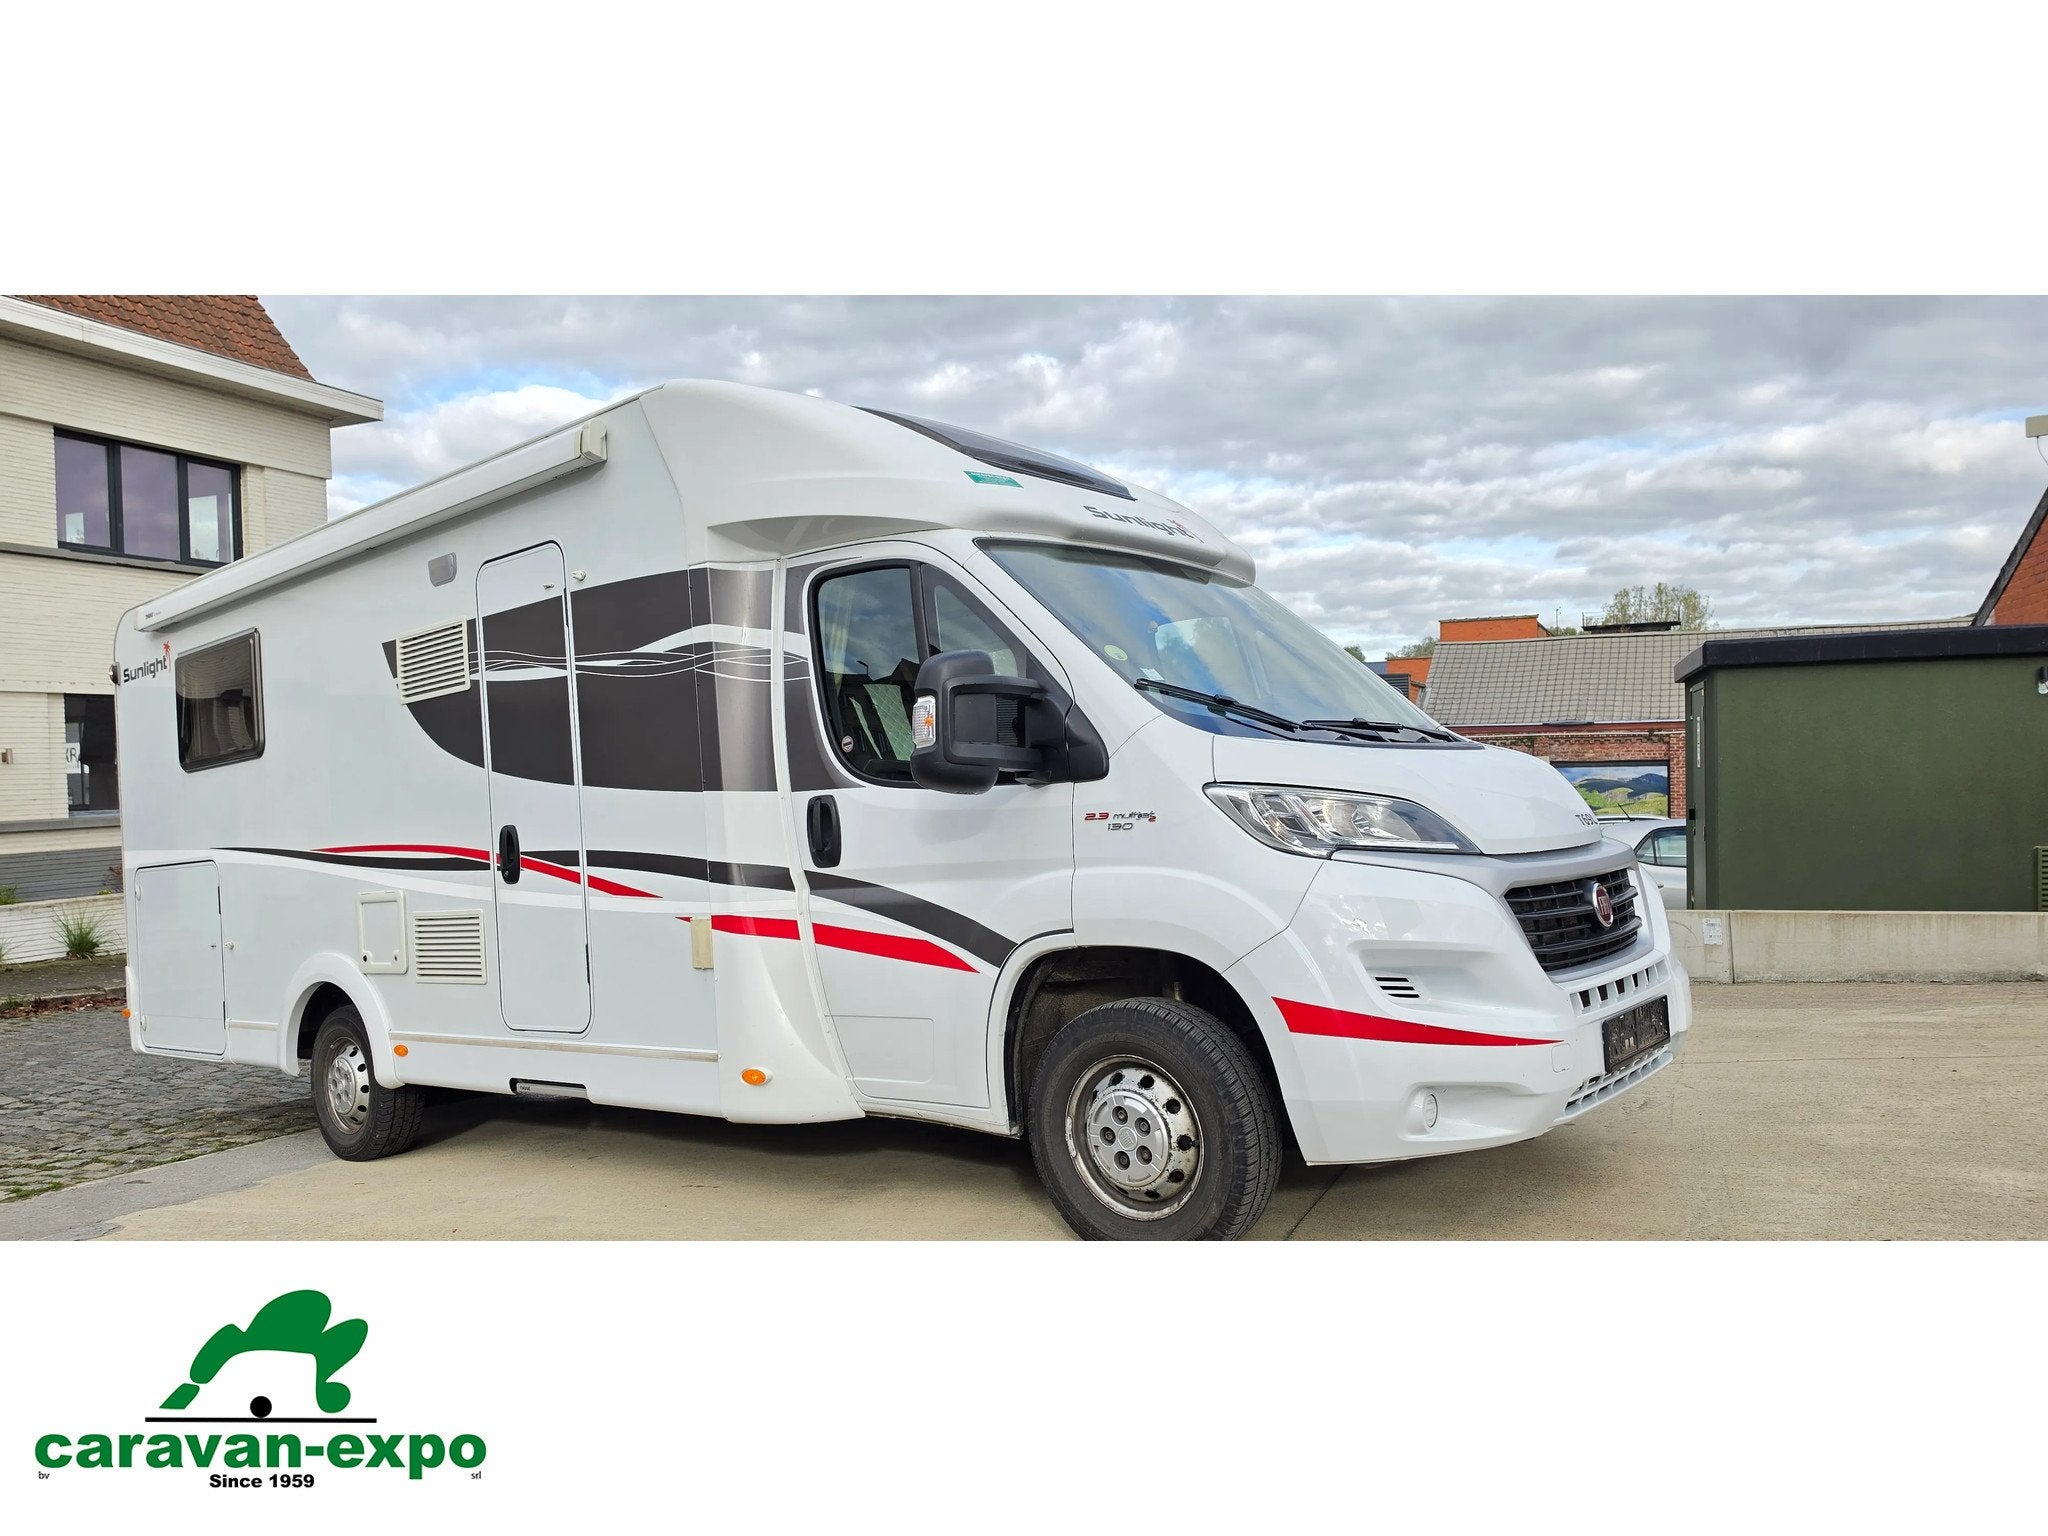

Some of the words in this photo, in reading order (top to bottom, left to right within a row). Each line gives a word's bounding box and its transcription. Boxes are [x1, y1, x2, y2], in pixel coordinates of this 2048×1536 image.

[1083, 505, 1195, 539] Sunlight
[123, 655, 167, 684] Sunlight
[1107, 822, 1134, 831] 130
